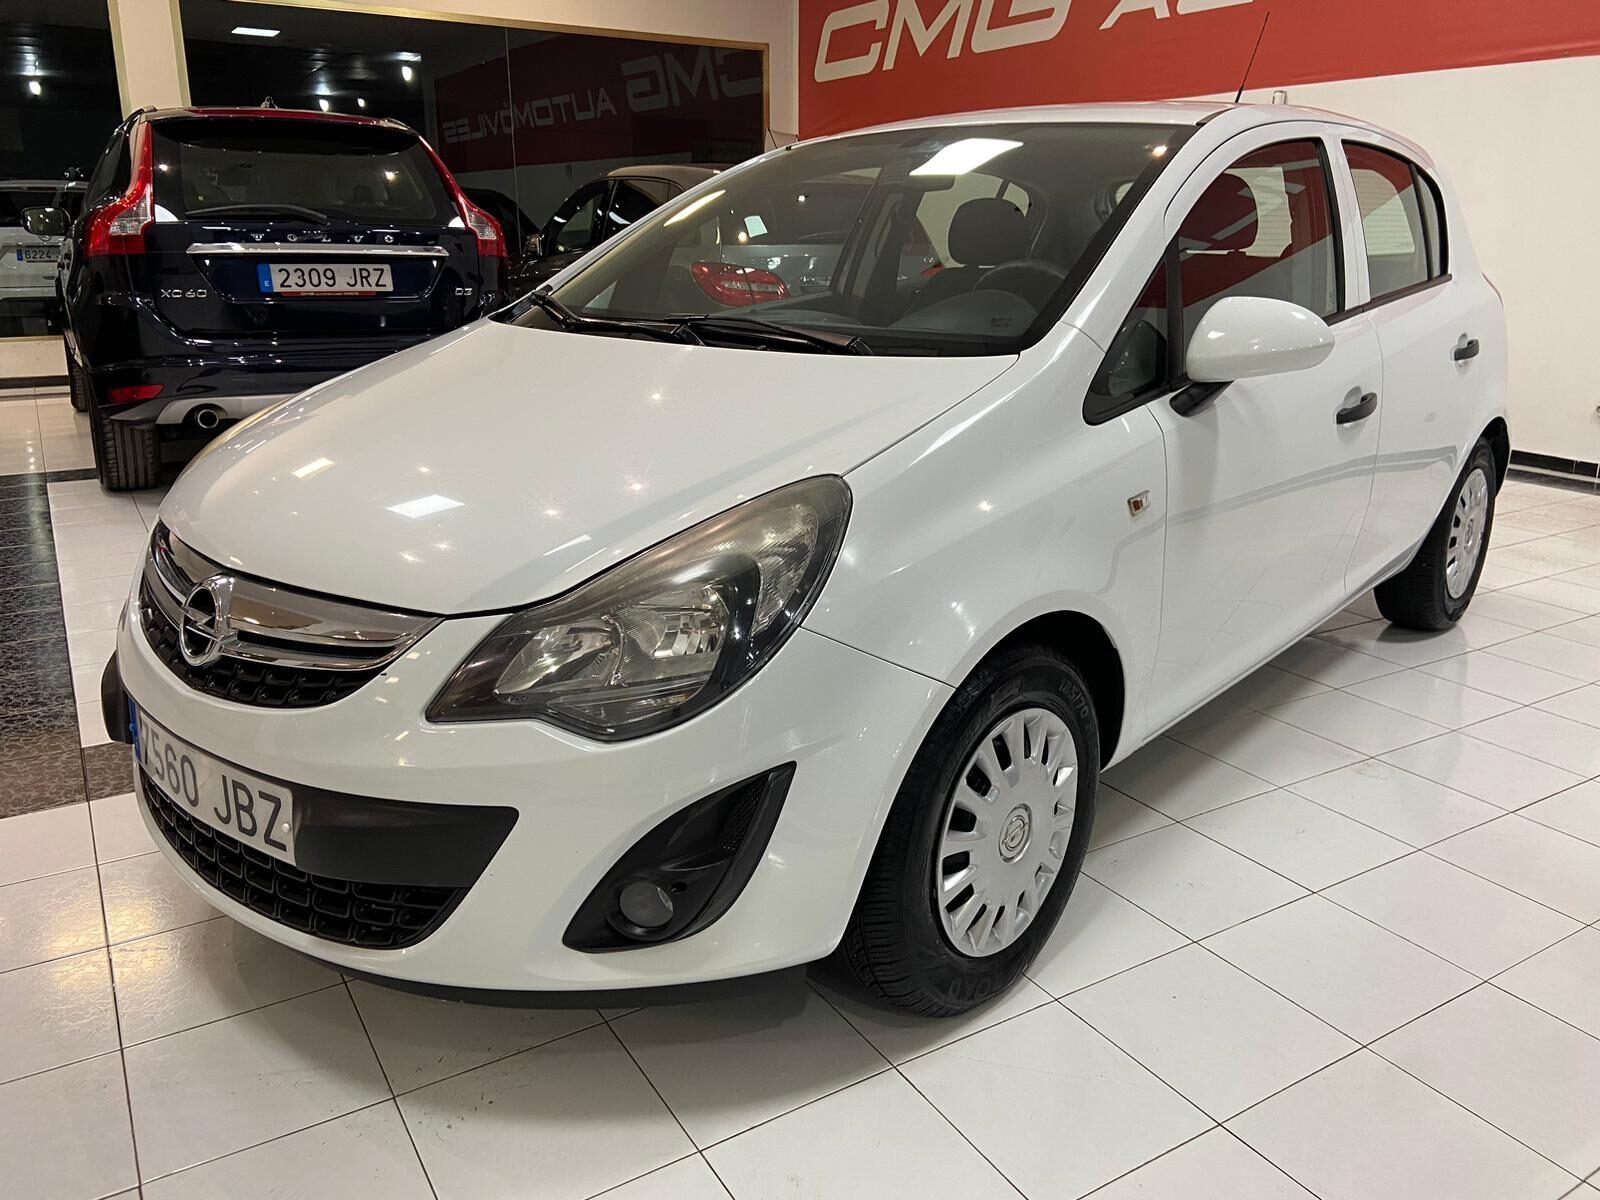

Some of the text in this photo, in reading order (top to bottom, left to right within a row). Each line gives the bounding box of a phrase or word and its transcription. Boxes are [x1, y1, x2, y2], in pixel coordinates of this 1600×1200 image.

[815, 0, 1071, 83] CMG
[25, 249, 51, 260] 8224
[278, 268, 387, 288] 2309 JRZ
[454, 287, 473, 297] D3
[139, 718, 288, 853] 7560 JBZ
